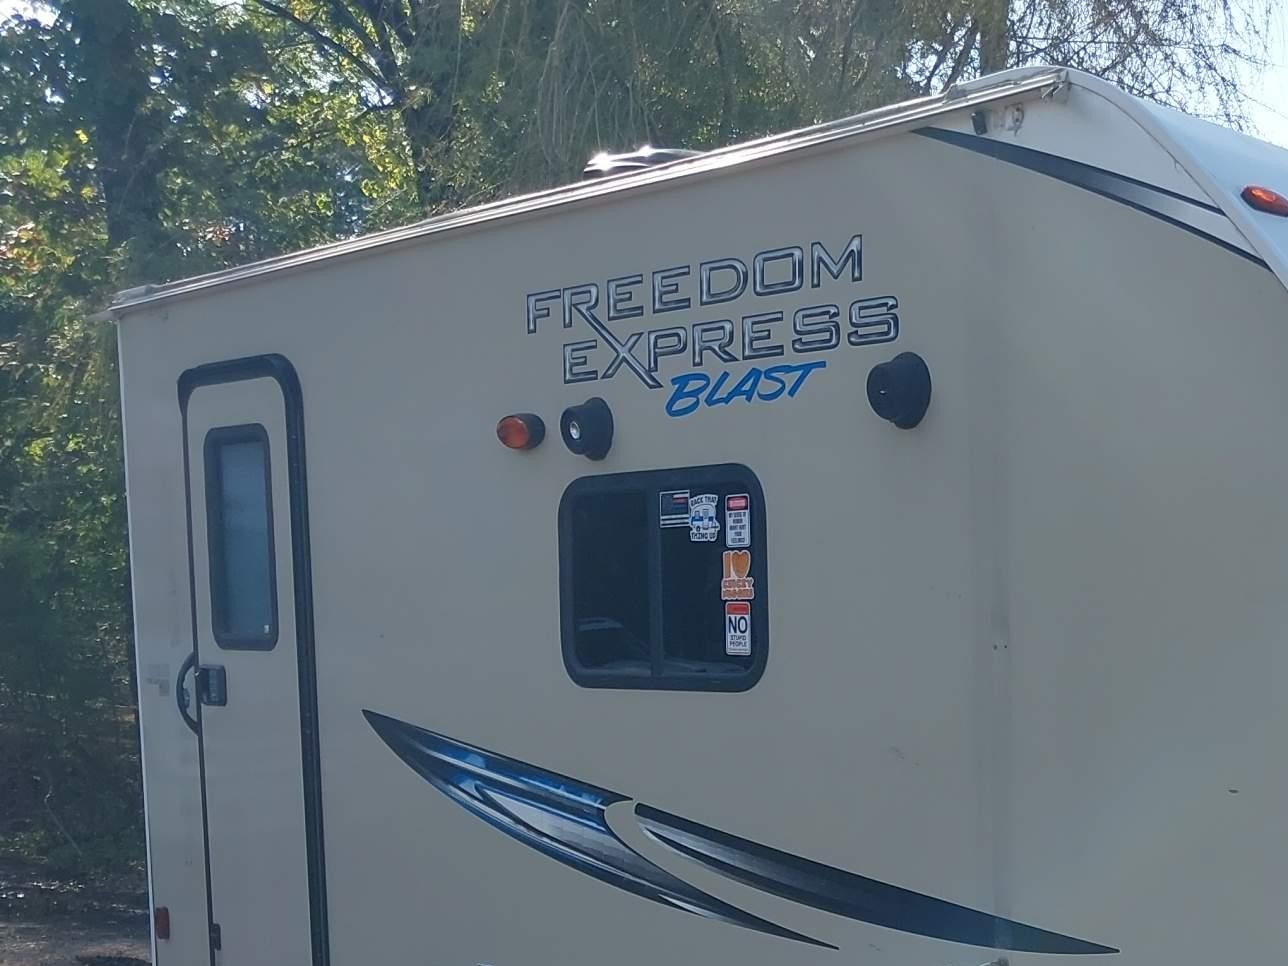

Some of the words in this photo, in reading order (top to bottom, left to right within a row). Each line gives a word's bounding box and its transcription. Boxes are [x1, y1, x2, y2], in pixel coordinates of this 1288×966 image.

[526, 233, 863, 335] FREEDOM
[563, 295, 899, 389] EXPRESS
[664, 360, 827, 418] BLAST
[728, 615, 748, 634] NO
